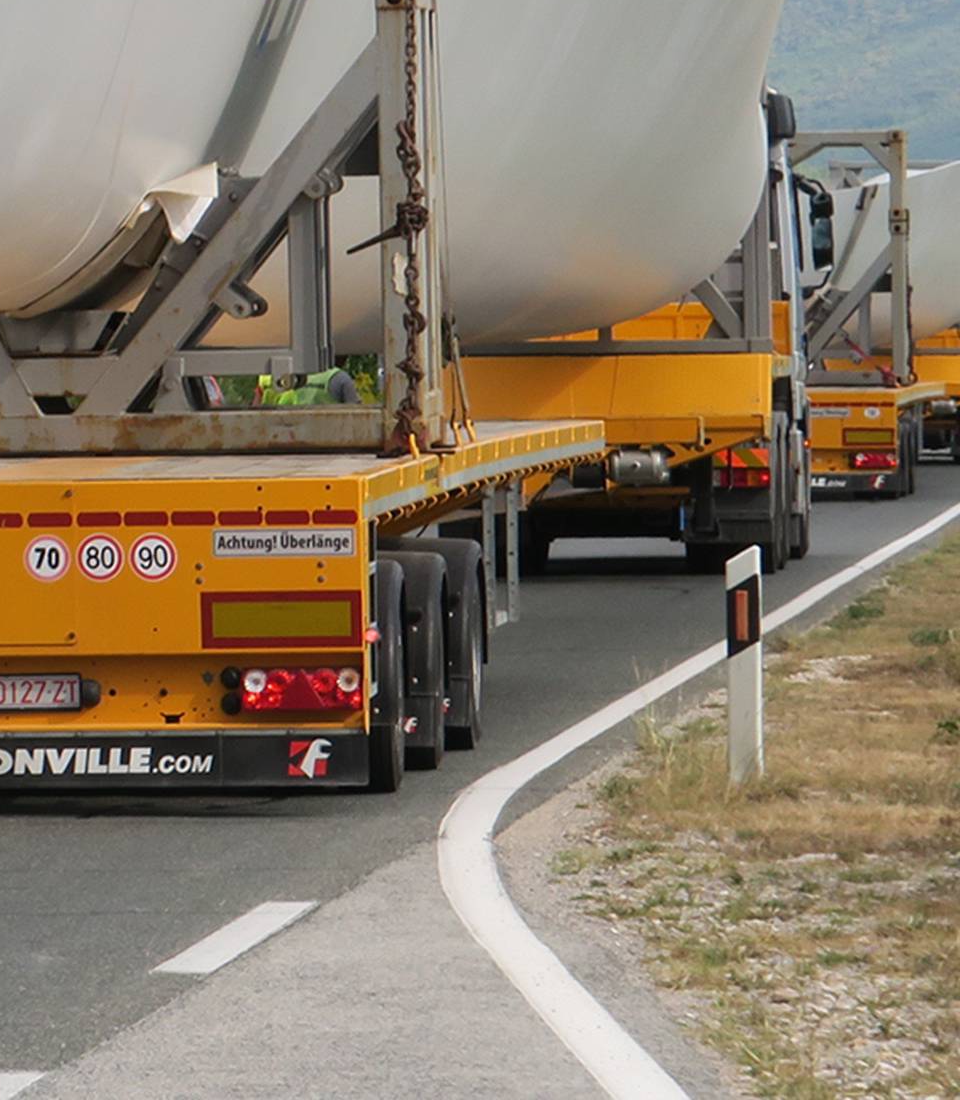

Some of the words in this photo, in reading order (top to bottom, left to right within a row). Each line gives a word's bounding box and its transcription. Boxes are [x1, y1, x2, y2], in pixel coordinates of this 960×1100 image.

[217, 535, 278, 553] Achtung!
[280, 530, 350, 552] Überlänge
[34, 547, 60, 570] 70
[86, 545, 115, 570] 80
[138, 544, 168, 570] 90
